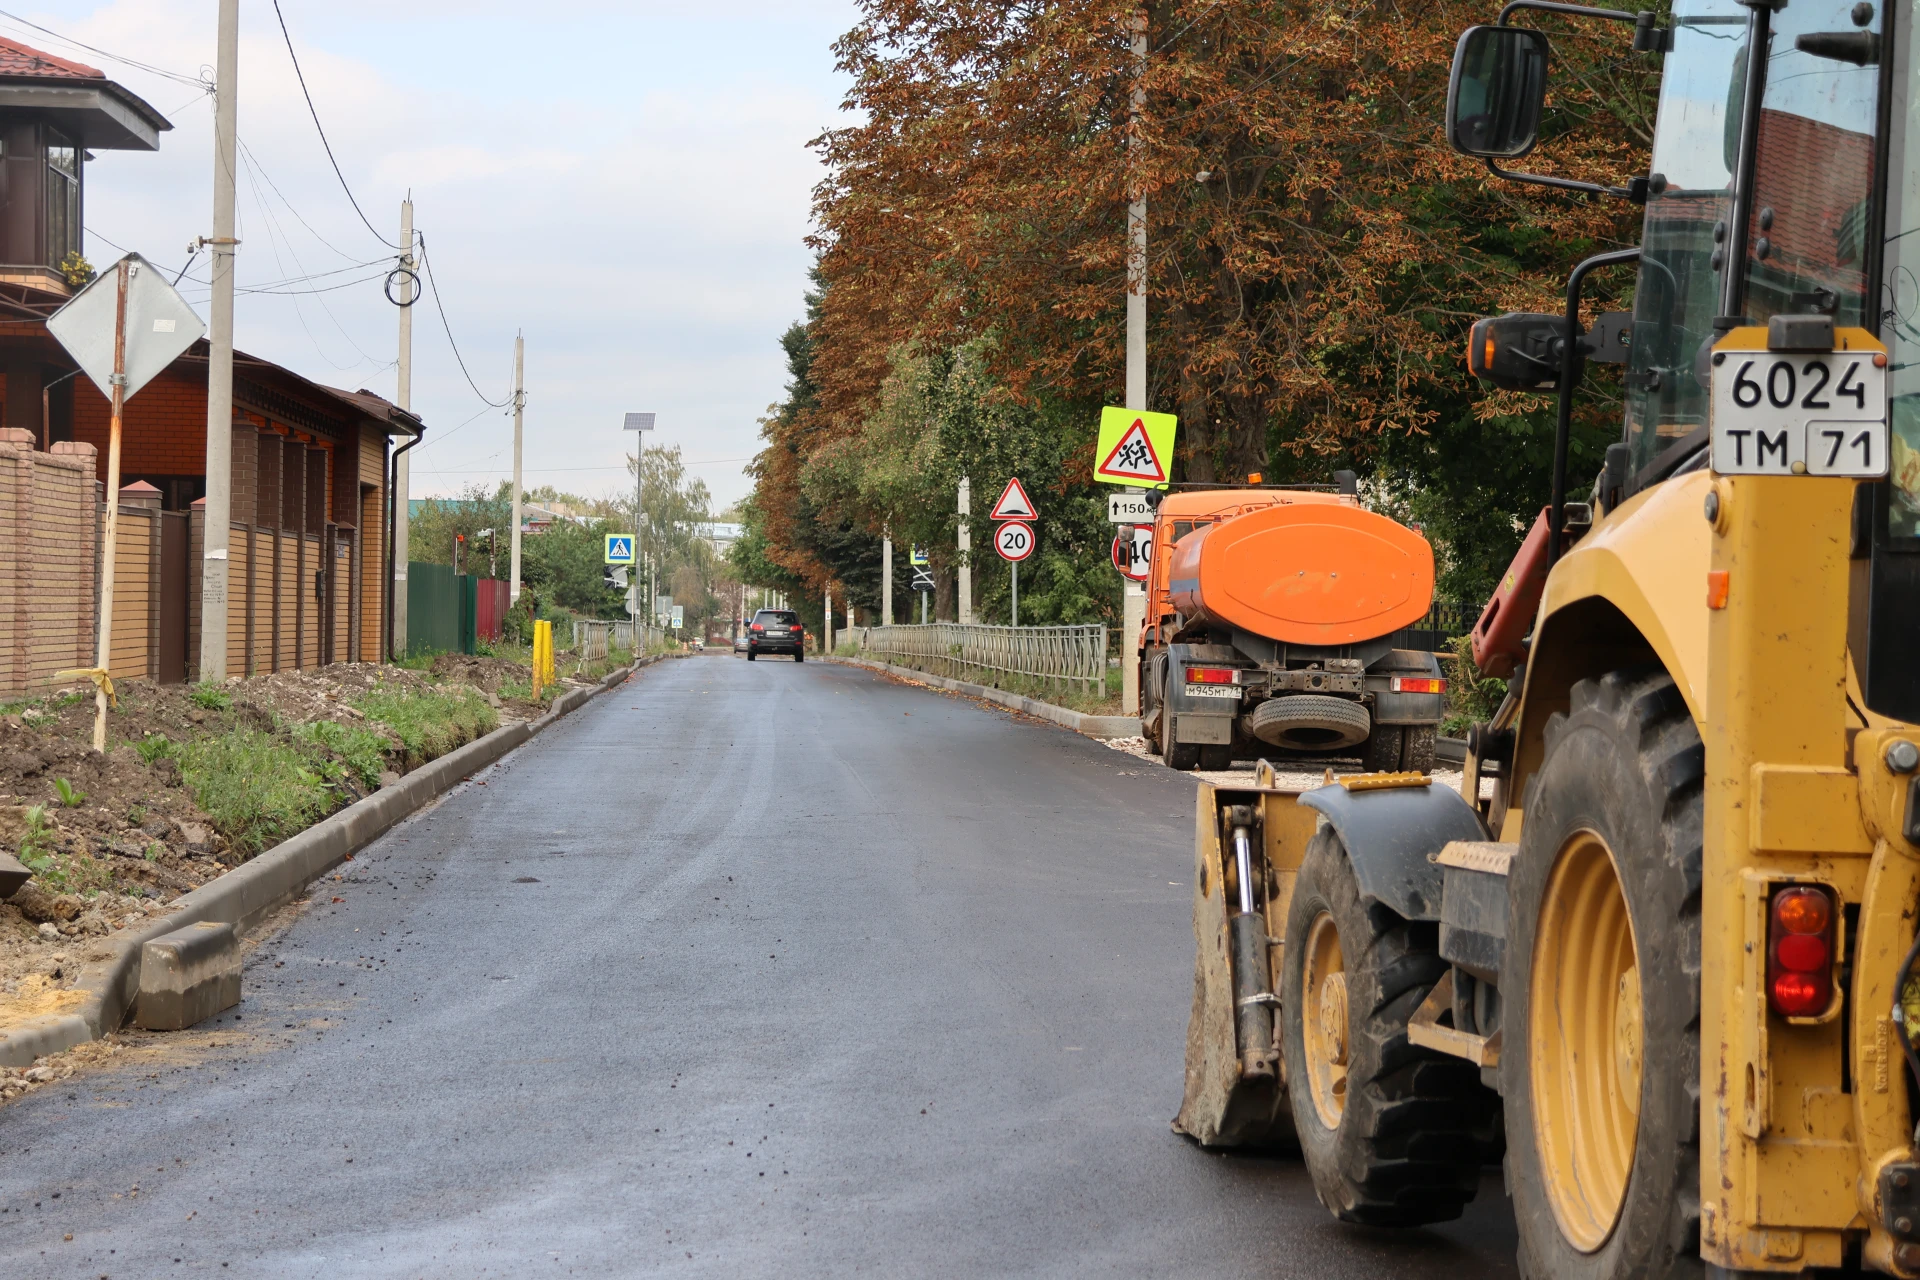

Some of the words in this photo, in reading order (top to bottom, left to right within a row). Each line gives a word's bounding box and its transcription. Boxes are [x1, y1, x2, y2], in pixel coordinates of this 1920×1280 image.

[1732, 361, 1865, 409] 6024
[1726, 430, 1787, 467] ТМ
[1821, 430, 1869, 467] 71
[1121, 503, 1145, 514] 150
[1003, 533, 1026, 550] 20
